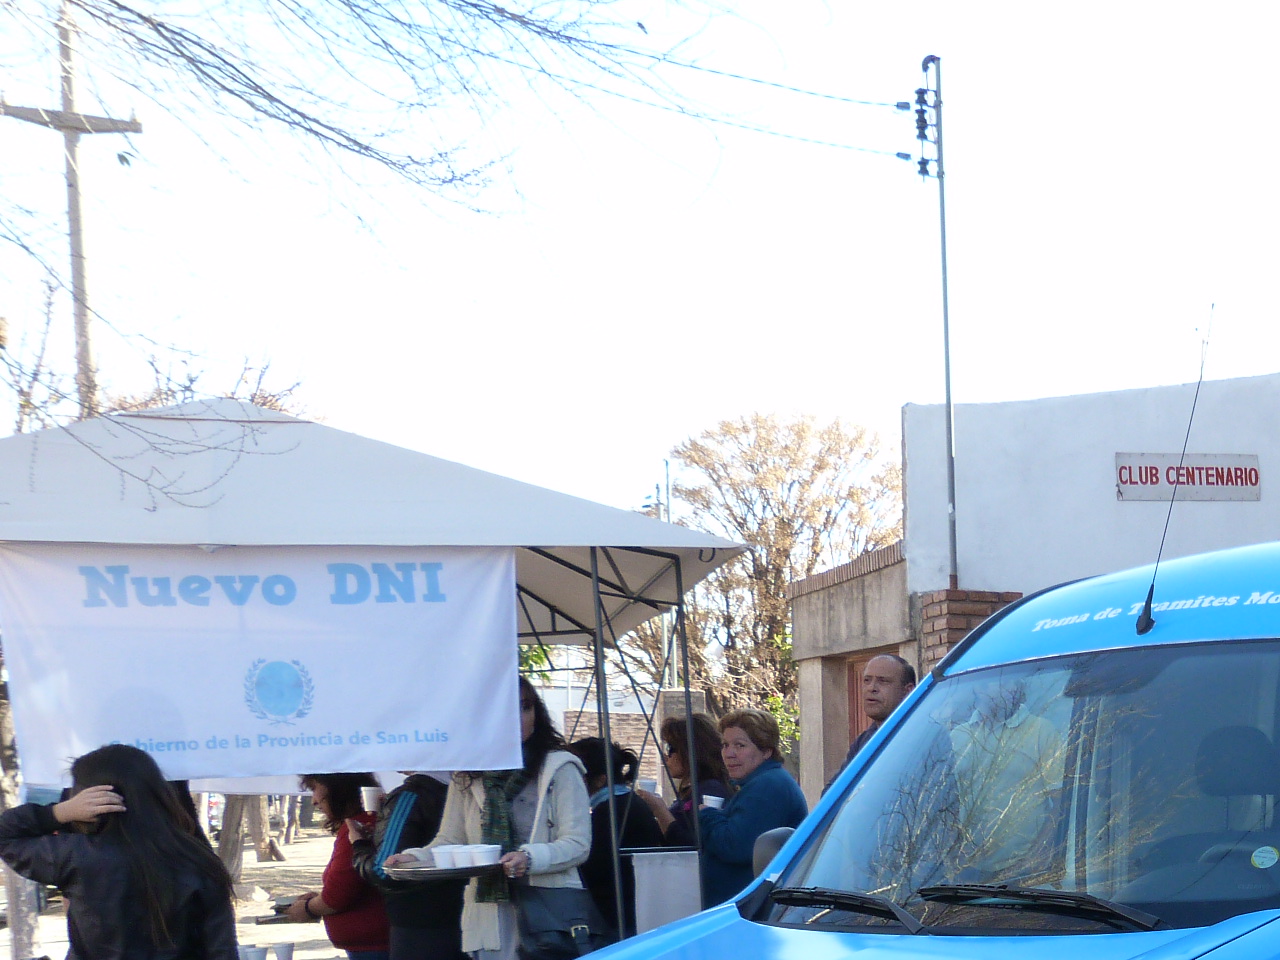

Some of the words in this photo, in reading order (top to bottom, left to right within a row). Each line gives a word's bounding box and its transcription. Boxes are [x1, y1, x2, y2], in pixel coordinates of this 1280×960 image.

[1118, 465, 1160, 486] CLUB
[1165, 465, 1260, 487] CENTENARIO
[78, 563, 298, 609] Nuevo
[325, 561, 448, 605] DNI
[1032, 612, 1088, 632] Toma
[1093, 607, 1122, 621] de
[205, 736, 229, 750] de
[234, 734, 251, 749] la
[257, 732, 344, 748] Provincia
[349, 731, 371, 746] de
[376, 731, 409, 745] San
[414, 729, 449, 744] Luis
